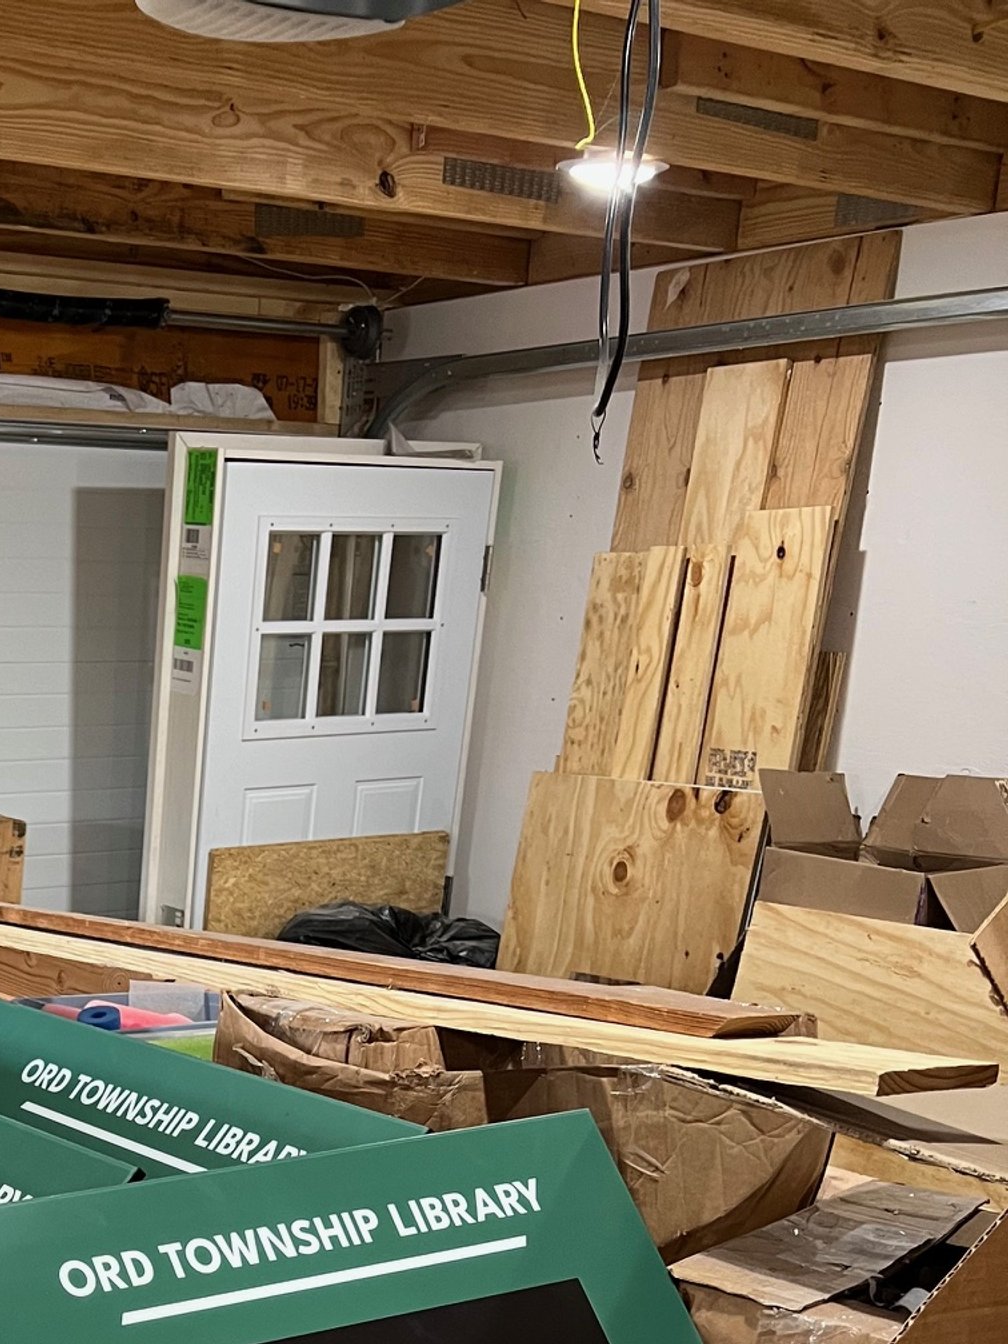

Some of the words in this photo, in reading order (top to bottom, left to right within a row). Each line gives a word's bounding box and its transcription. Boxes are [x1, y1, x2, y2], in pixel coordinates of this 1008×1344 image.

[20, 1058, 72, 1094] ORD
[69, 1073, 200, 1138] TOWNSHIP
[194, 1119, 307, 1164] LIBRA
[58, 1250, 155, 1298] ORD
[157, 1208, 380, 1280] TOWNSHIP
[387, 1177, 542, 1238] LIBRARY
